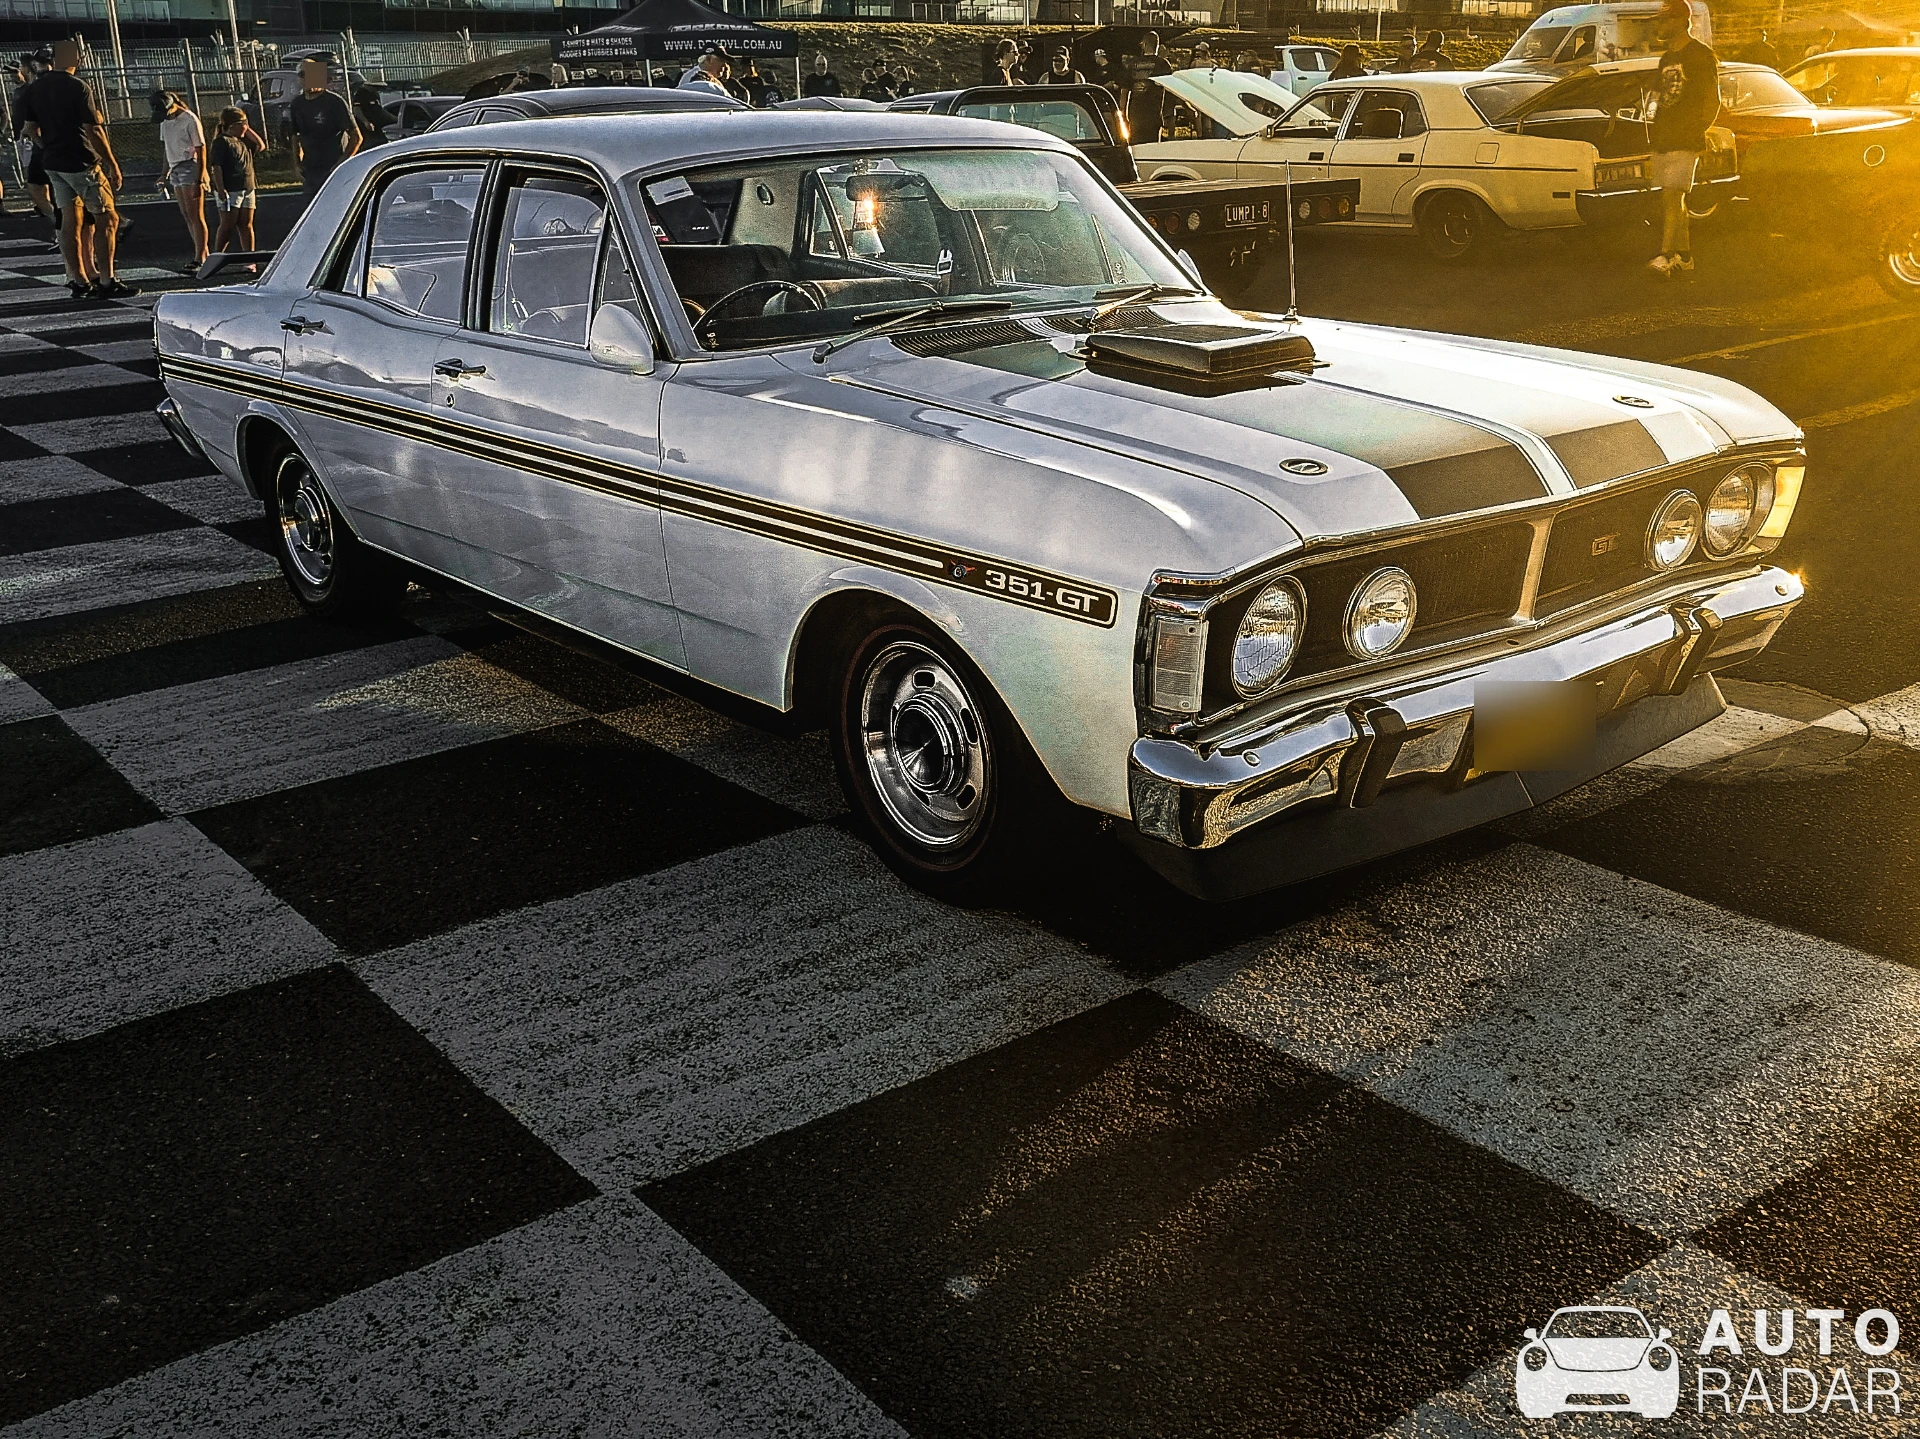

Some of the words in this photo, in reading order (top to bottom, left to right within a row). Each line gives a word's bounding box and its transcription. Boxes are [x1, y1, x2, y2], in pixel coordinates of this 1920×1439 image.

[562, 39, 585, 48] T-SHIRTS
[591, 37, 605, 46] HATS
[610, 37, 632, 46] SHADES
[663, 39, 782, 51] WWW.DKDVL.COM.AU
[559, 49, 582, 59] HOODIES
[587, 48, 613, 57] STUBBIES
[619, 47, 638, 56] TANKS
[985, 569, 1099, 613] 351-GT
